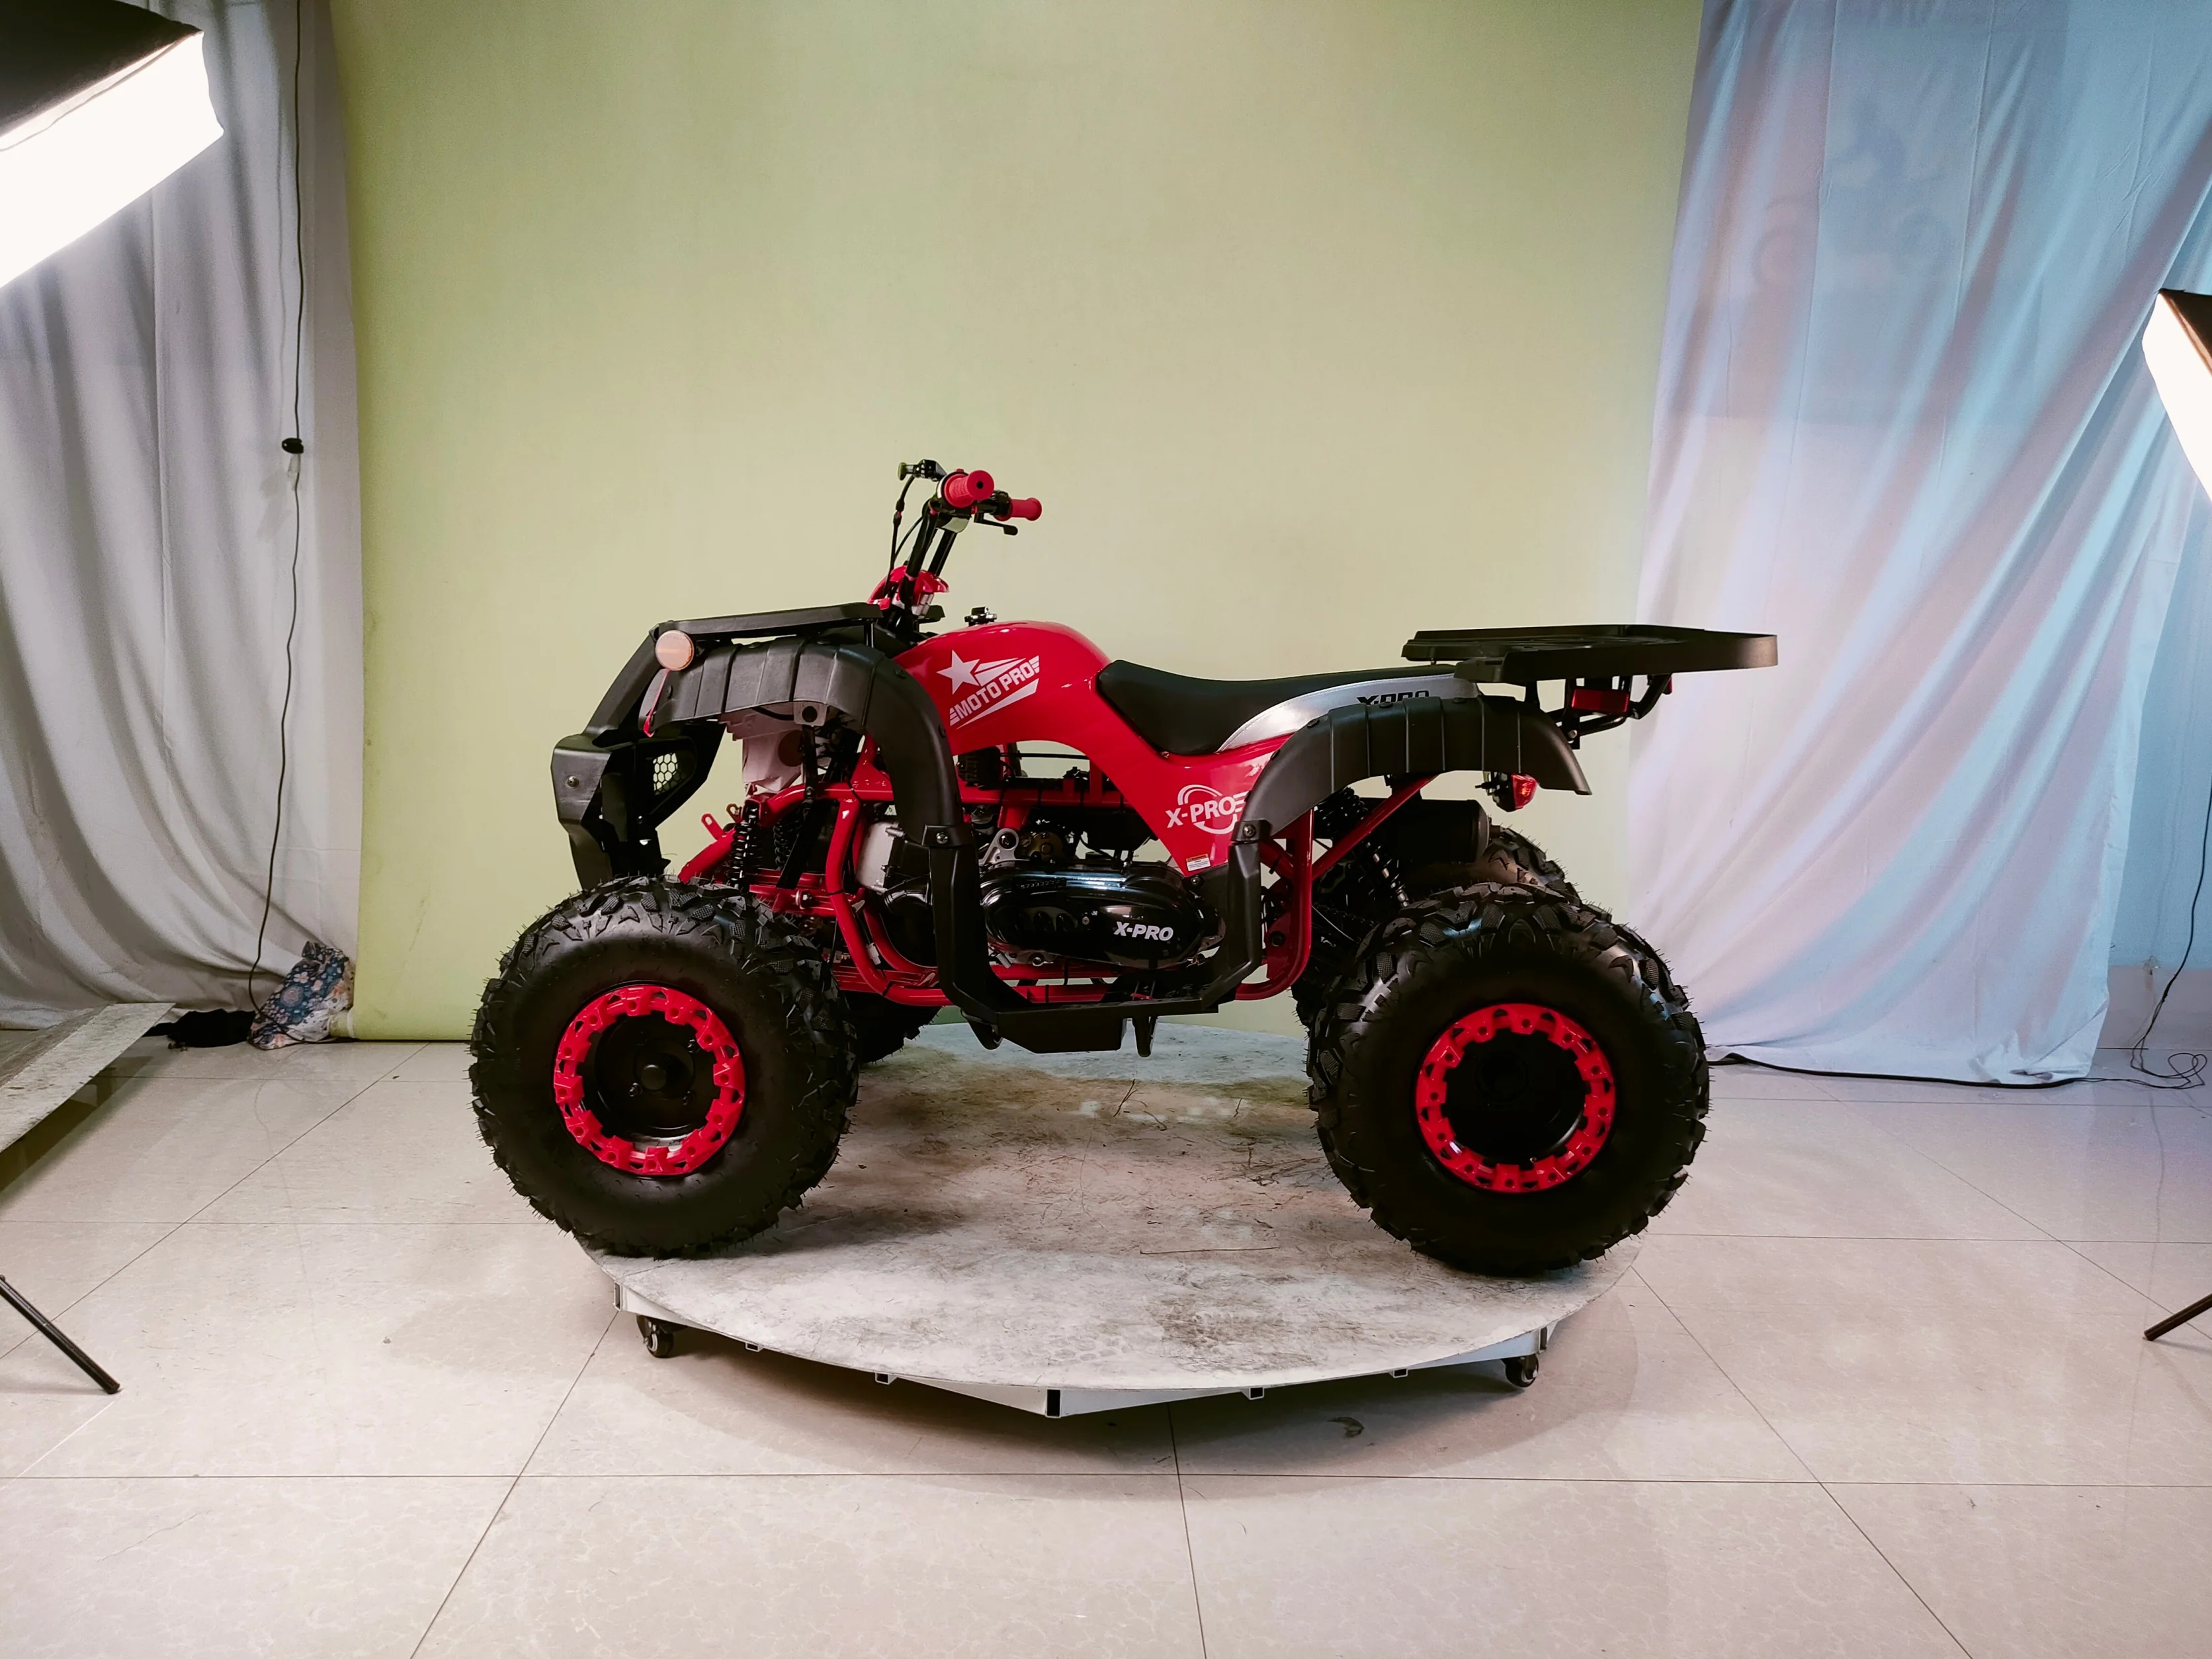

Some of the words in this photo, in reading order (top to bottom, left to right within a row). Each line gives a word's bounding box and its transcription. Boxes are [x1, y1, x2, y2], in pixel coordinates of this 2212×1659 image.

[955, 681, 1001, 719] MOTO
[998, 663, 1035, 691] PRO
[1165, 796, 1236, 828] X-PRO
[1113, 921, 1173, 941] X-PRO
